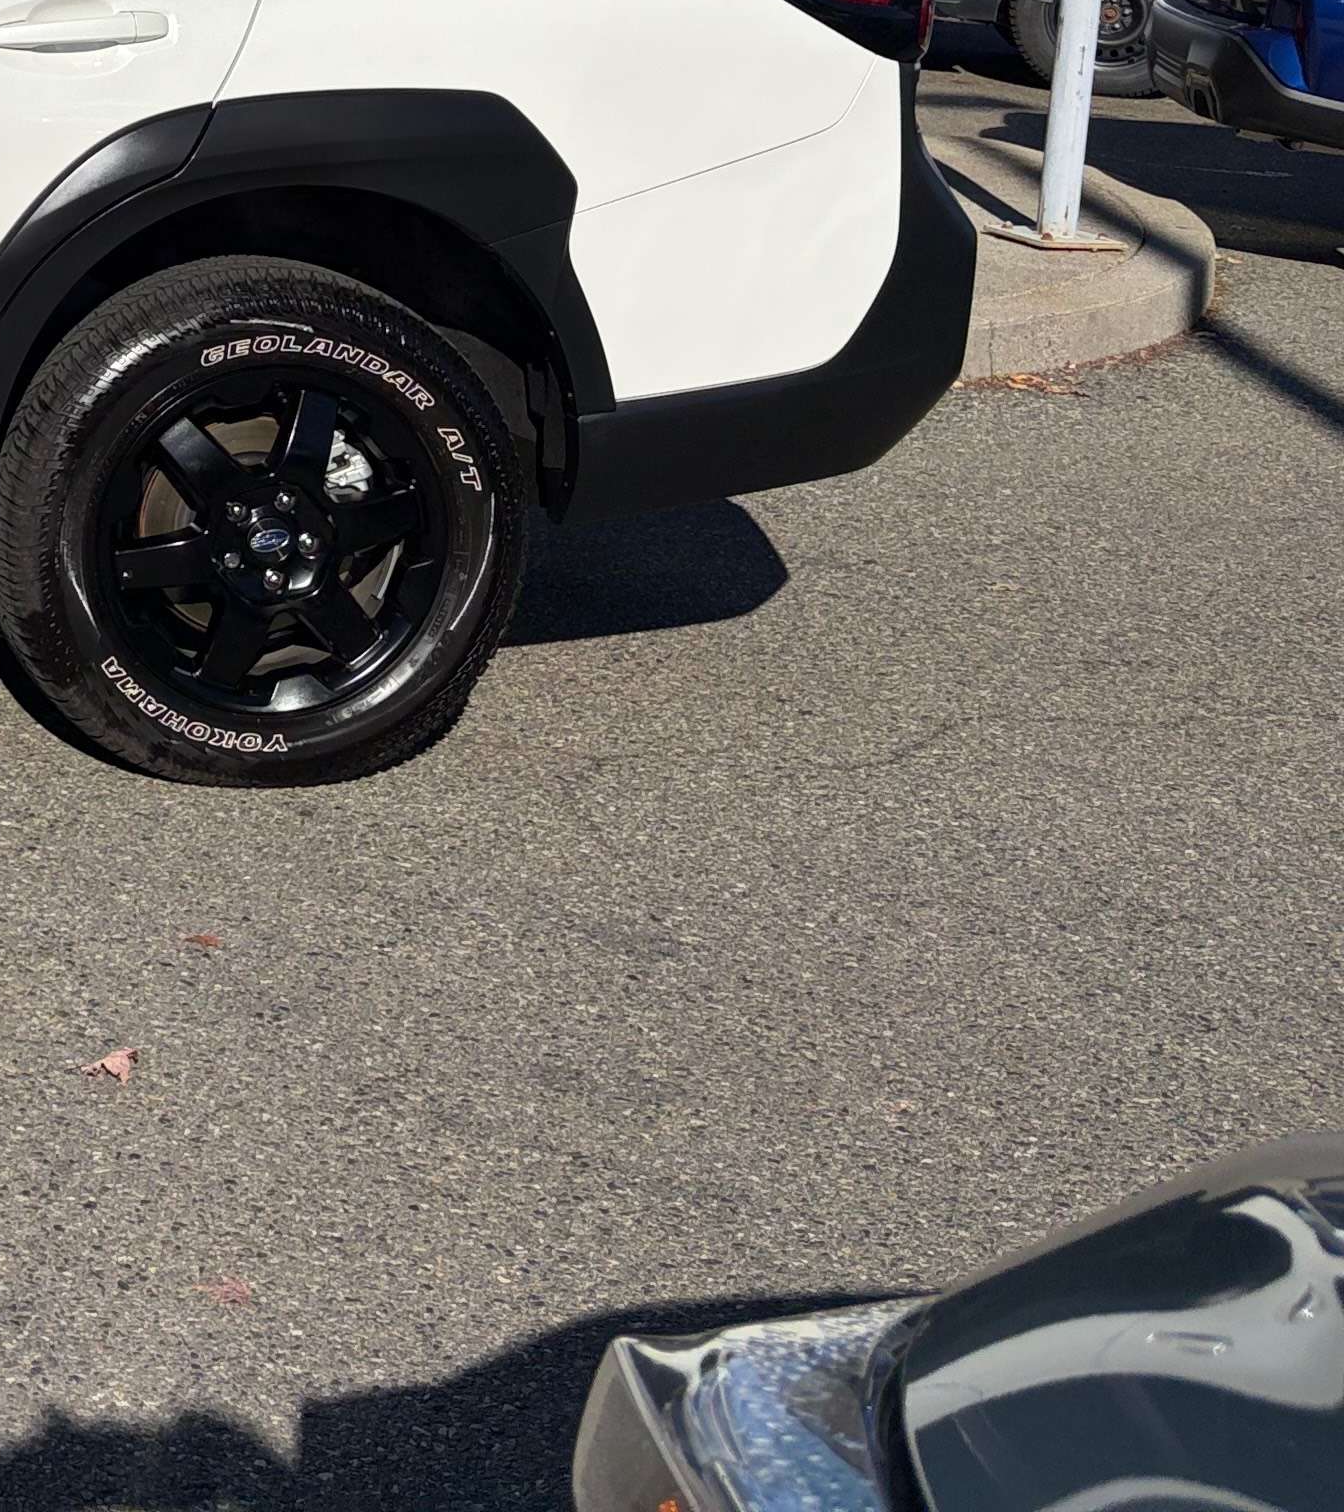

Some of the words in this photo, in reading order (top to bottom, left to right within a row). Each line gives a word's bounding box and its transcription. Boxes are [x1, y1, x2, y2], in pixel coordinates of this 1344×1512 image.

[200, 335, 435, 411] GEOLANDAR
[437, 426, 483, 492] A/T
[100, 655, 289, 753] YOKOHAMA
